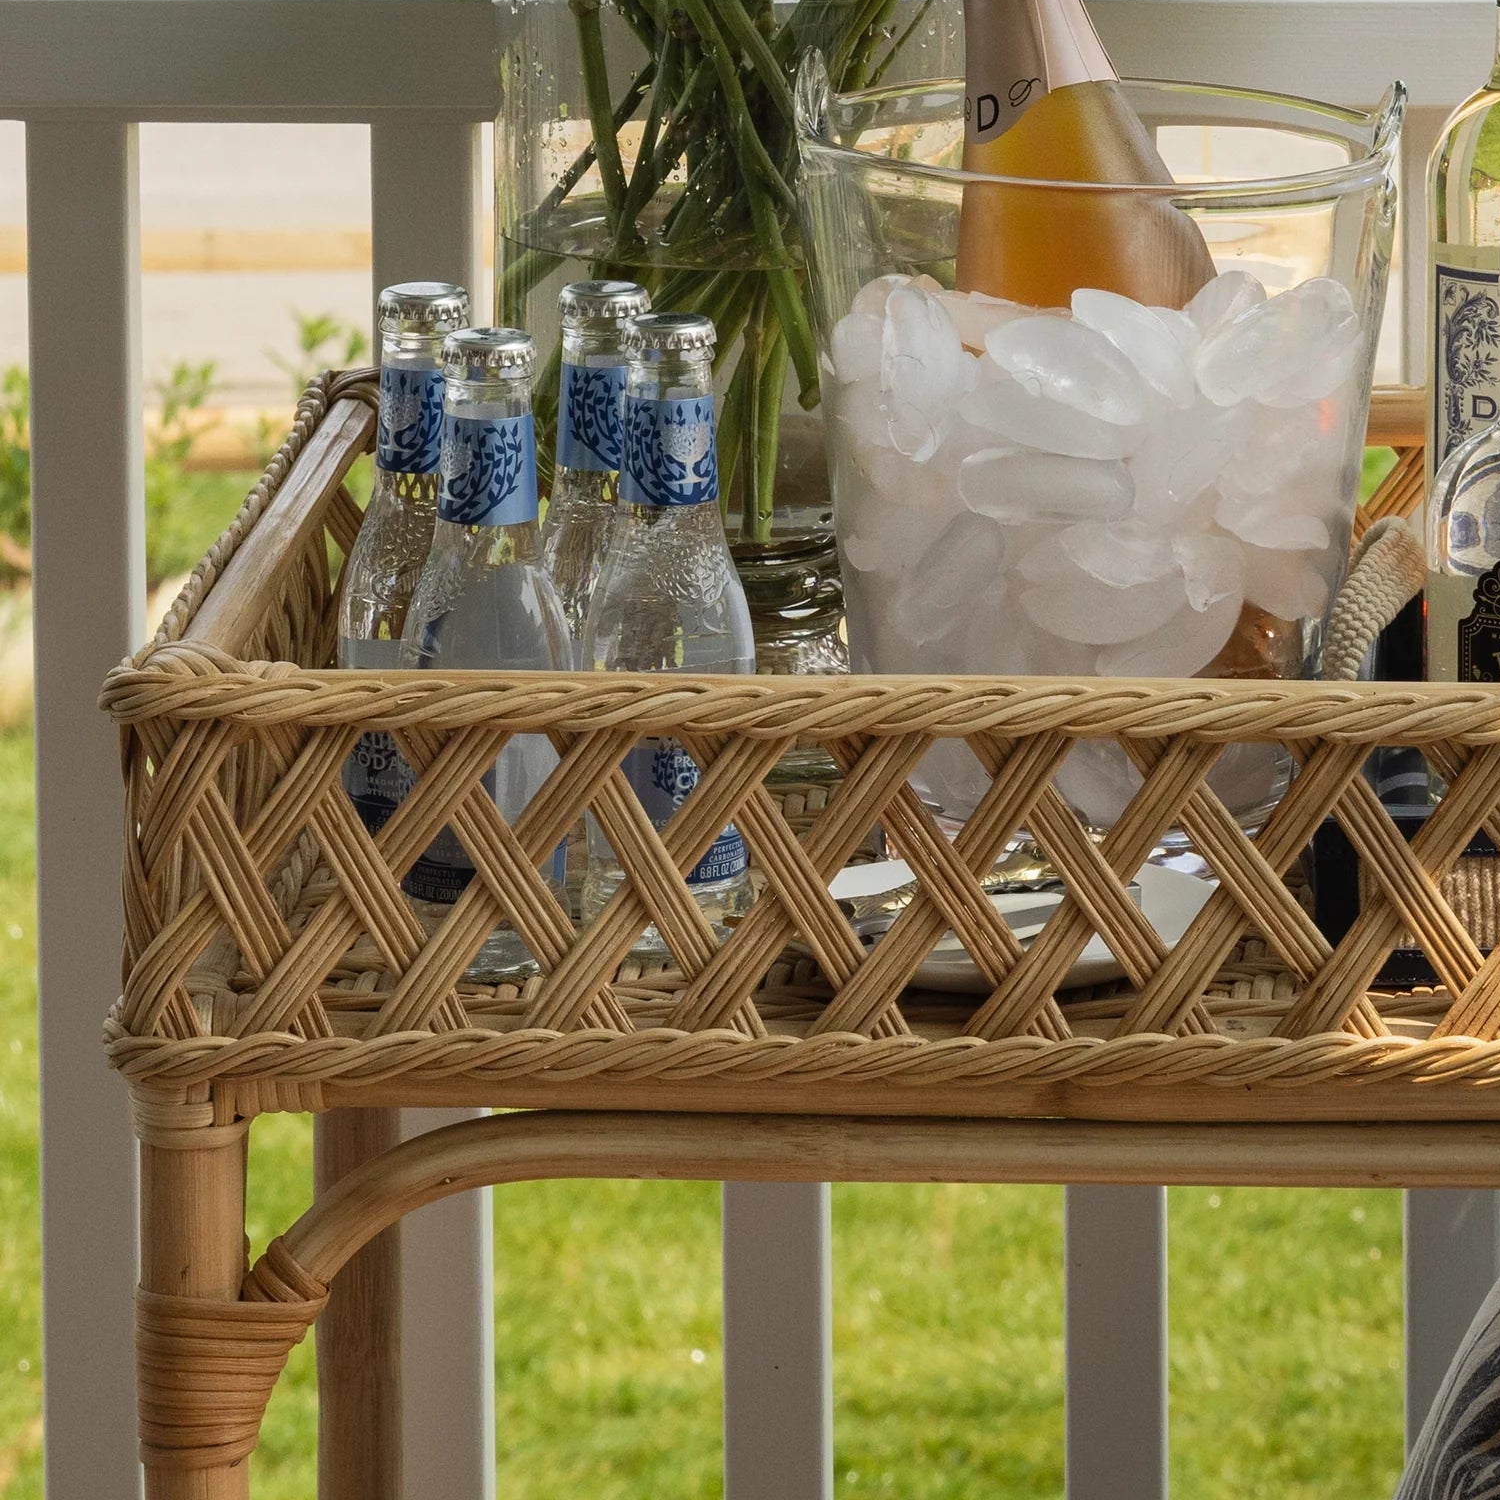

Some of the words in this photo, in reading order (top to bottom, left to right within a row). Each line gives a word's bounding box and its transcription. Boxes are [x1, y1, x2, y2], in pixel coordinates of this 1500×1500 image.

[713, 839, 743, 854] PERFECTLY
[700, 866, 712, 879] 6.8
[712, 865, 720, 877] FL
[721, 862, 729, 876] OZ
